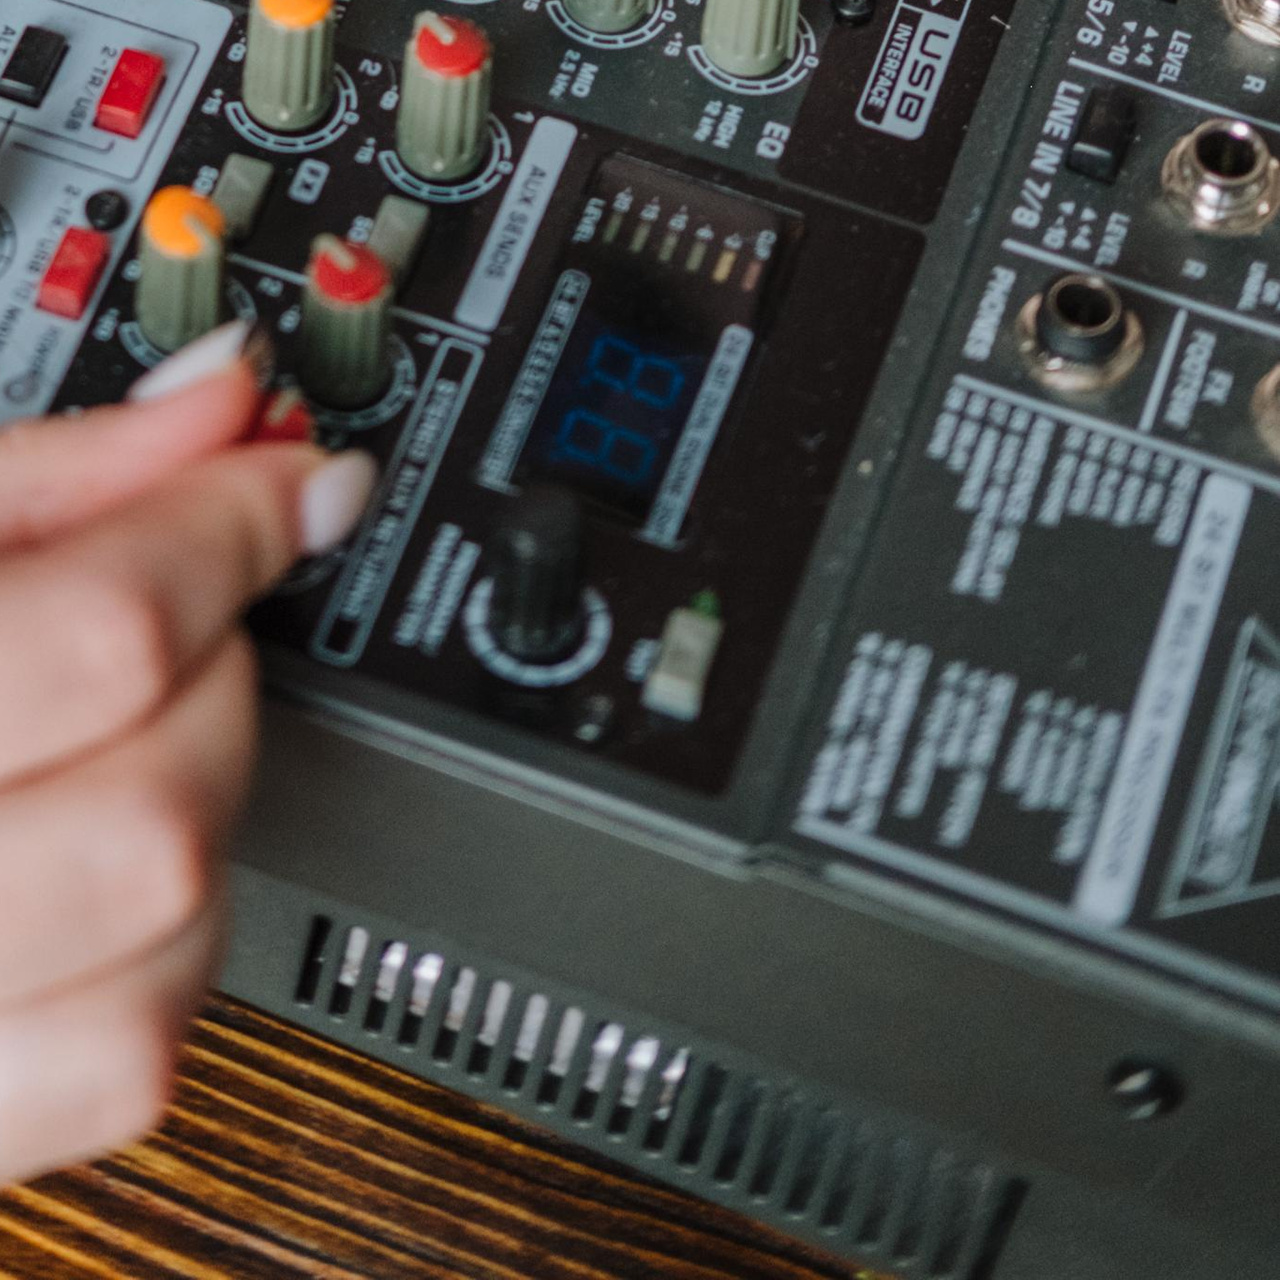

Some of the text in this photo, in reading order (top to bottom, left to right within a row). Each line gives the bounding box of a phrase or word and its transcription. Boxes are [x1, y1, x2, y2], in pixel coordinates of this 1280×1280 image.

[358, 58, 382, 77] 2
[664, 31, 684, 58] +15
[867, 21, 914, 110] INTERFACE
[1107, 34, 1131, 67] -10
[1134, 43, 1155, 68] +4
[1157, 28, 1193, 83] LEVEL
[65, 44, 117, 132] 2-TR/USB
[571, 61, 600, 100] MID
[894, 28, 950, 123] USB
[1241, 73, 1267, 94] R
[713, 103, 745, 149] HIGH
[756, 120, 791, 160] EQ
[1011, 79, 1086, 230] LINE IN 7/8
[484, 163, 547, 280] AUX SENDS
[1093, 211, 1132, 268] LEVEL
[961, 264, 1018, 363] PHONES
